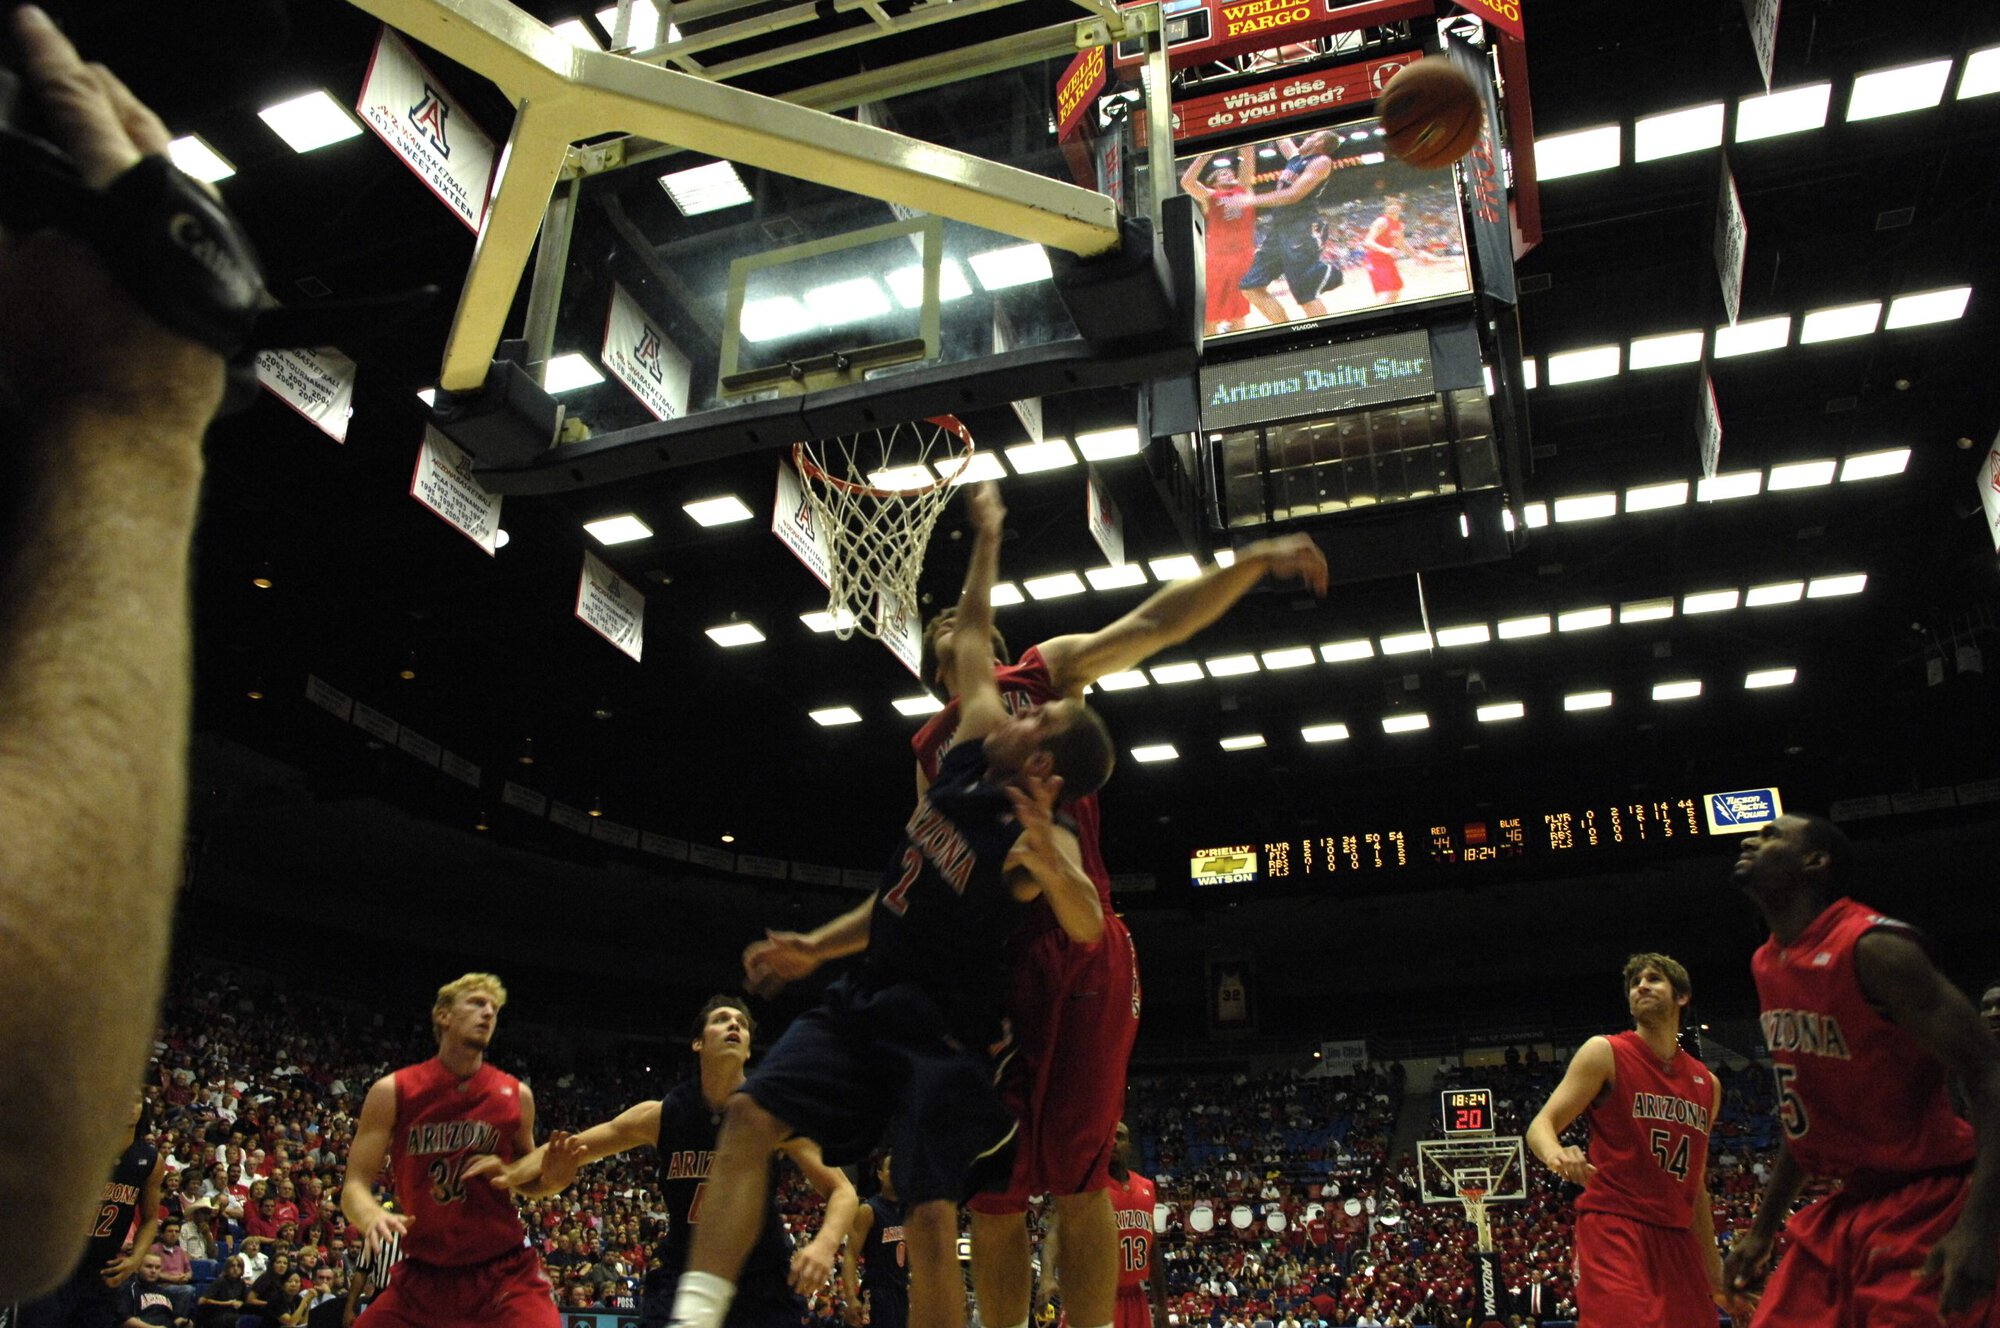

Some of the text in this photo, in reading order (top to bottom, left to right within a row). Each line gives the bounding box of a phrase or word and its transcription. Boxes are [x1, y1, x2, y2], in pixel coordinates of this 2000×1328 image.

[1228, 8, 1311, 37] FARGO
[1059, 58, 1104, 126] FARGO
[1224, 79, 1326, 110] What else
[1207, 86, 1345, 127] do you need?
[396, 136, 431, 174] SWEET
[432, 174, 473, 220] SIXTEEN
[1291, 322, 1319, 332] VIACOM
[256, 357, 271, 372] 005
[275, 370, 294, 390] 2006
[265, 354, 285, 374] 2002
[288, 372, 307, 391] 2003
[285, 358, 335, 398] TOURNAMENT
[1211, 357, 1424, 407] Arizona Daily Star
[626, 372, 650, 400] SWEET
[651, 398, 673, 421] SIXTE
[431, 470, 448, 486] NCAA
[1725, 795, 1761, 805] Tucson
[1732, 801, 1769, 812] Electric
[1544, 812, 1572, 824] PLYR
[1736, 809, 1770, 819] Power
[1430, 826, 1446, 836] RED
[1500, 818, 1520, 829] BLUE
[1550, 821, 1569, 832] PTS
[1264, 842, 1290, 853] PLYR
[1365, 833, 1380, 843] 50
[1388, 831, 1404, 840] 54
[1433, 836, 1450, 848] 44
[1505, 828, 1522, 841] 46
[1550, 830, 1572, 841] RBS
[1196, 845, 1250, 858] O'RIELLY
[1551, 839, 1573, 850] FLS
[1269, 851, 1287, 860] PTS
[1464, 846, 1496, 861] 18:24
[1268, 859, 1289, 868] RBS
[1197, 873, 1253, 886] WATSON
[1269, 868, 1290, 877] FLS
[882, 848, 923, 917] 2
[1452, 1093, 1486, 1107] 18:24
[1456, 1109, 1482, 1129] 20
[1632, 1092, 1708, 1135] ARIZONA
[406, 1120, 501, 1156] ARIZONA
[1650, 1128, 1690, 1182] 54
[1120, 1235, 1148, 1271] 13
[1480, 1256, 1496, 1317] ARIZONA
